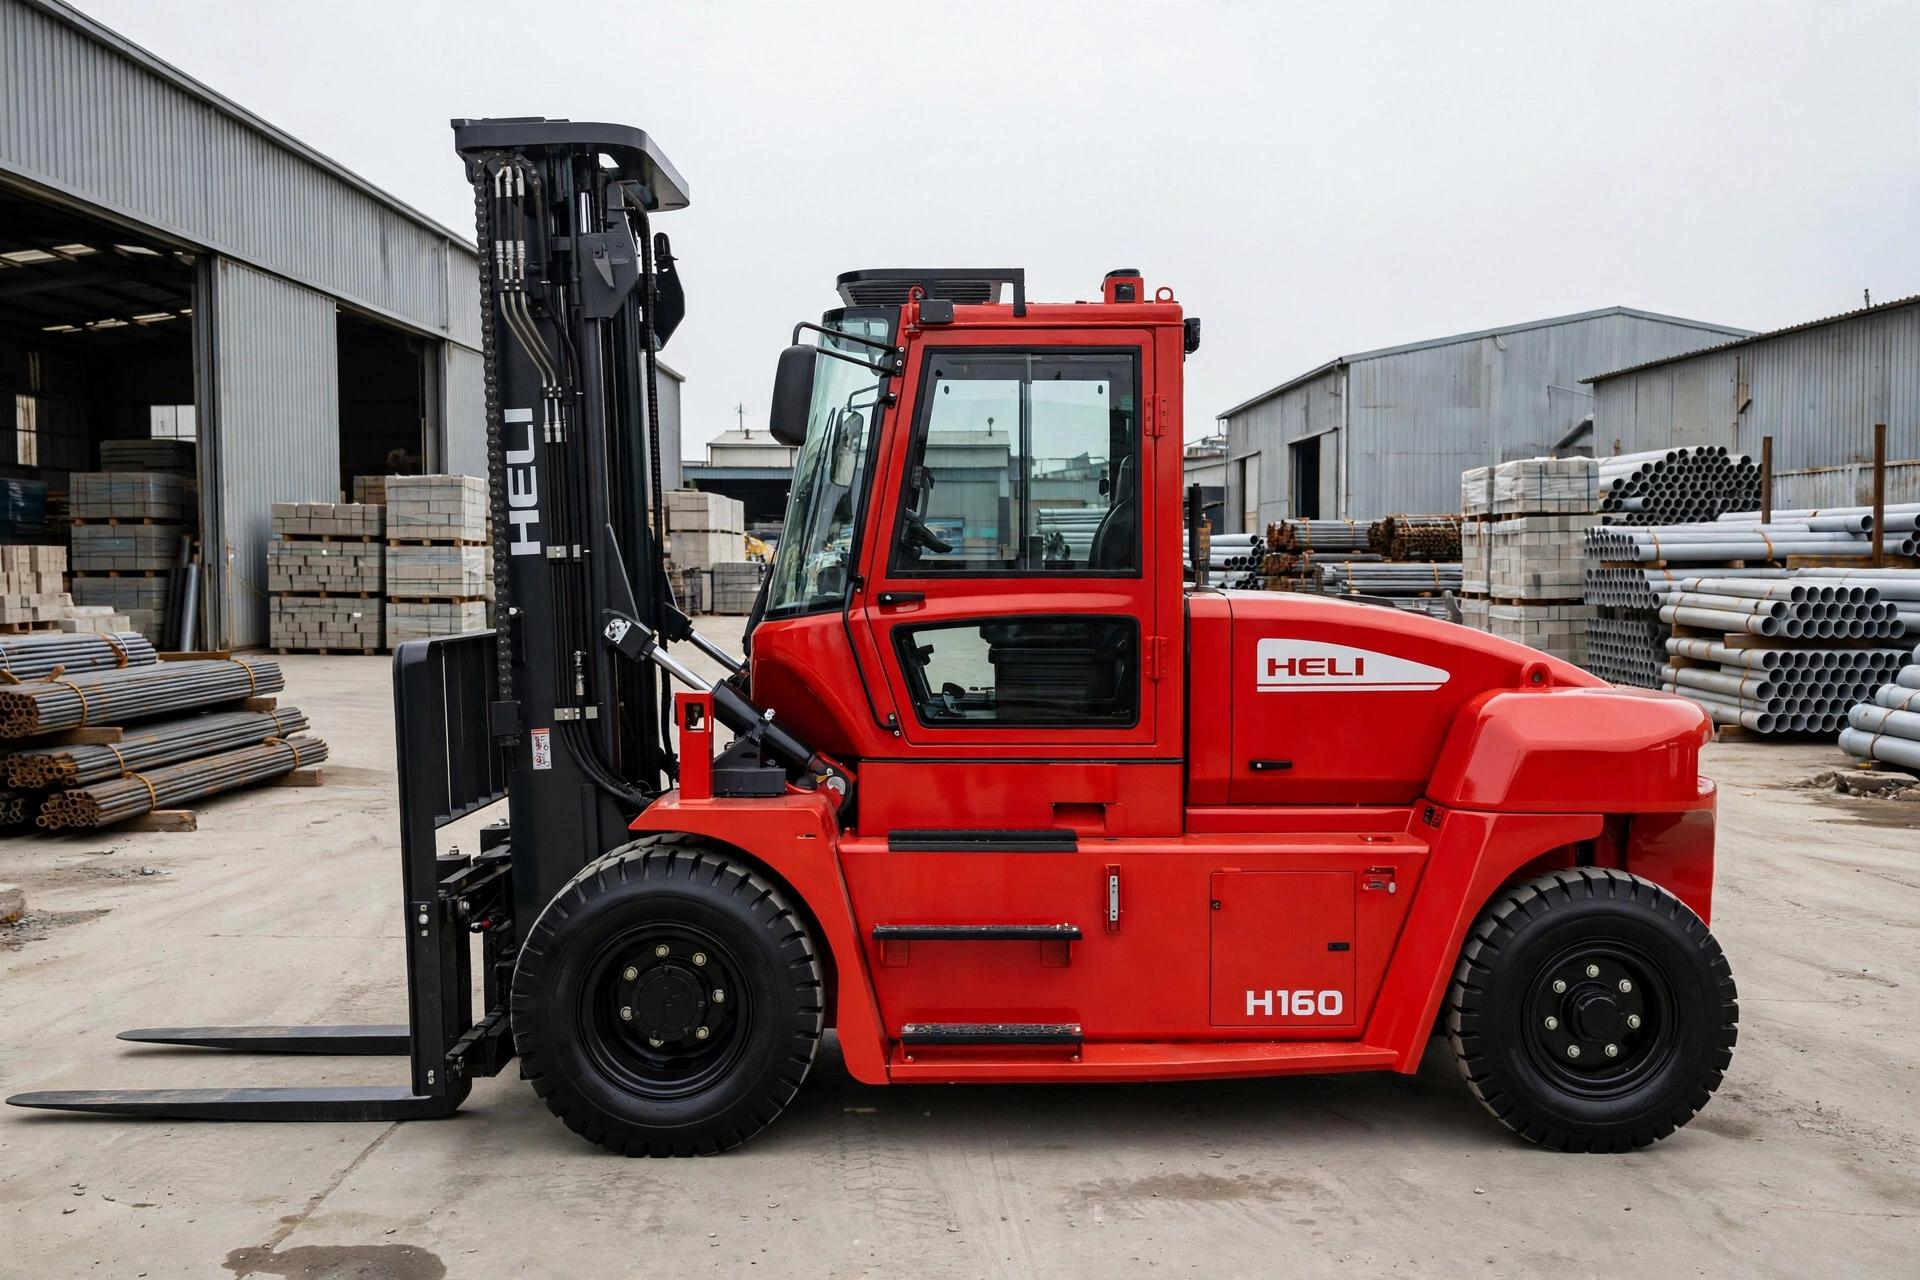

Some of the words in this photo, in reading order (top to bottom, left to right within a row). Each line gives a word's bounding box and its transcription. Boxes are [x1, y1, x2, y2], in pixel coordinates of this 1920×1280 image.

[504, 408, 541, 556] HELI
[1267, 657, 1364, 677] HELI
[1246, 990, 1343, 1016] H160
